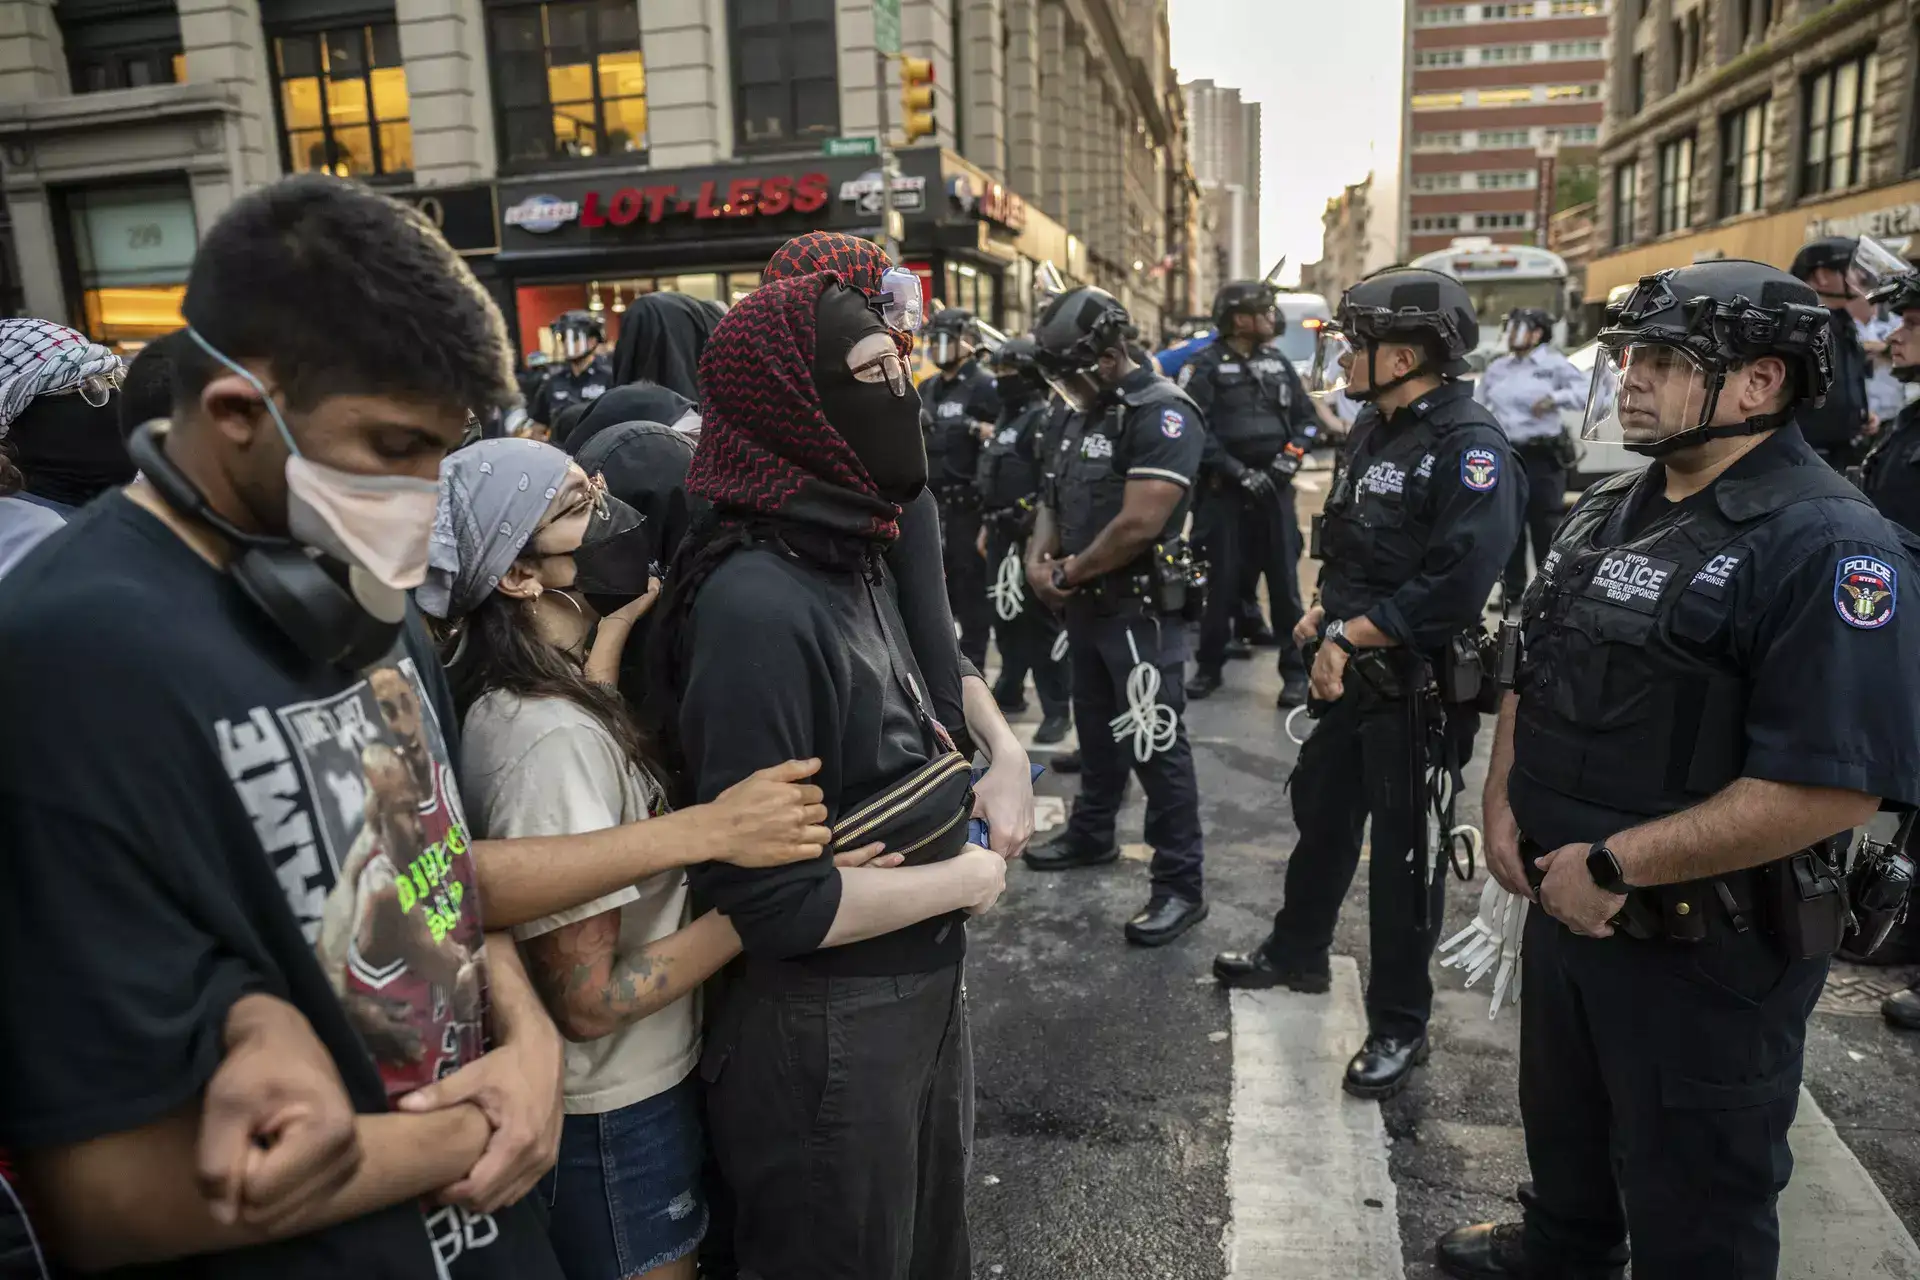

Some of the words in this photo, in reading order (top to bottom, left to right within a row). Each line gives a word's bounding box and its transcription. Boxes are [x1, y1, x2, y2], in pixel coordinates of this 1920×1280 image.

[580, 172, 830, 228] LOT-LESS
[1364, 465, 1406, 486] POLICE
[1624, 553, 1649, 566] NYPD
[1597, 557, 1668, 590] POLICE
[1844, 560, 1891, 582] POLICE
[1592, 576, 1624, 591] STRATEGIC
[1624, 584, 1660, 601] RESPONSE
[1606, 588, 1632, 602] GROUP
